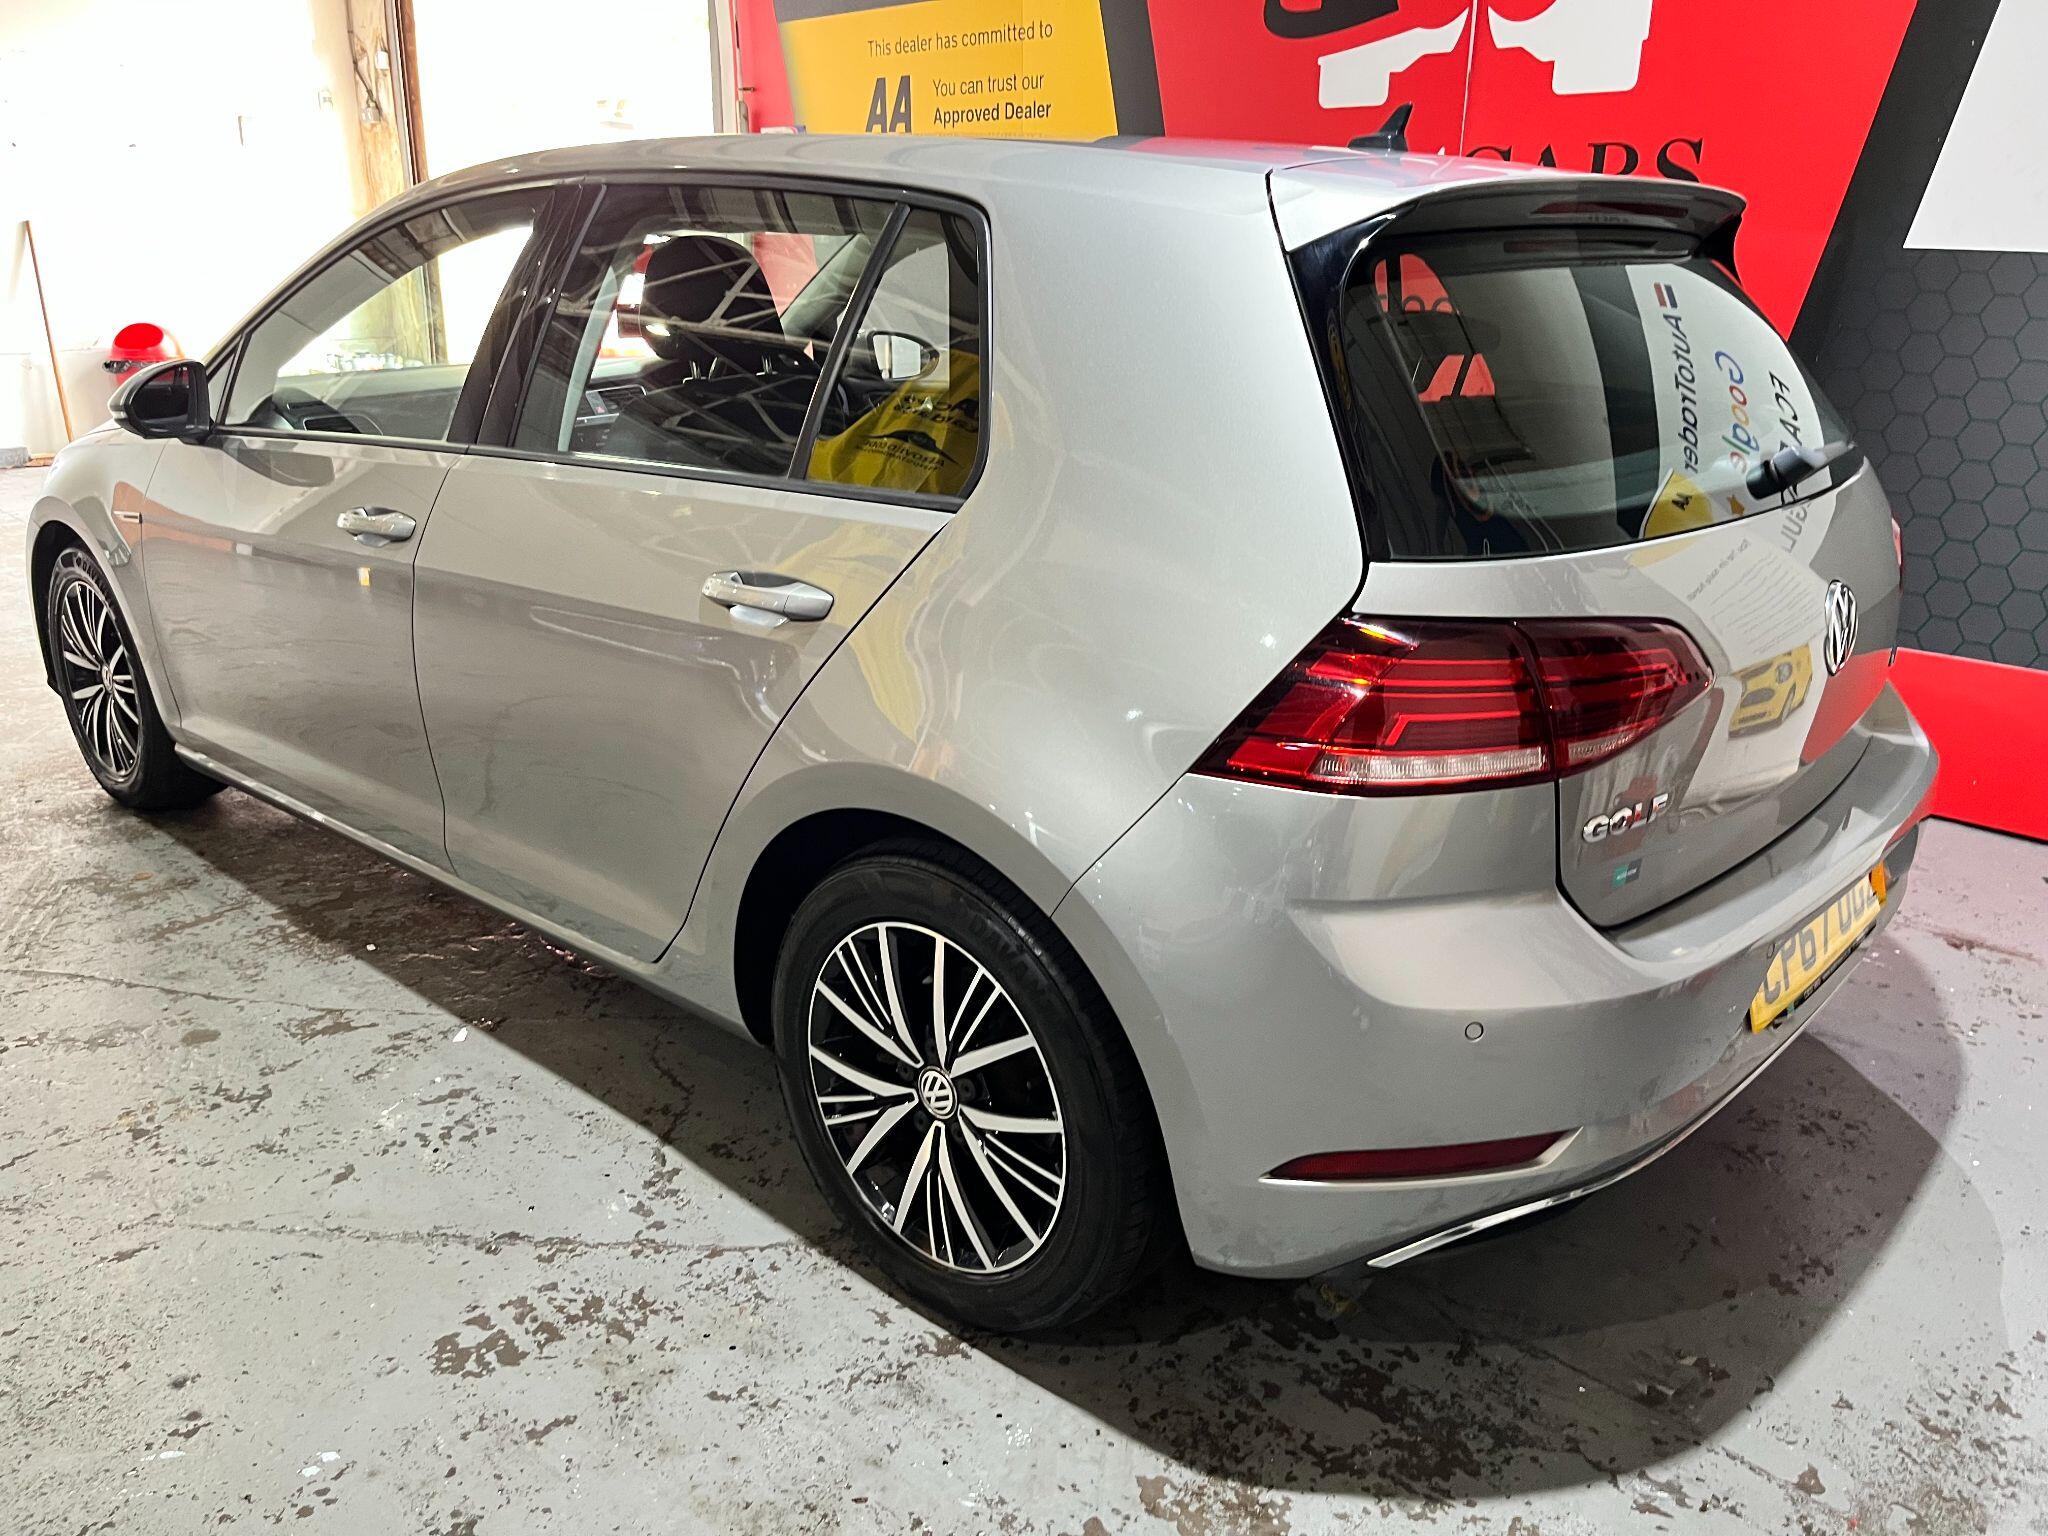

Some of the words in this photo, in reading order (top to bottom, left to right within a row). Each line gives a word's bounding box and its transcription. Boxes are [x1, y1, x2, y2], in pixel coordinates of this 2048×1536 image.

[868, 40, 891, 58] This
[895, 36, 932, 54] dealer
[936, 33, 957, 50] has
[962, 21, 1035, 46] committed
[1039, 20, 1053, 38] to
[865, 75, 912, 133] AA
[932, 79, 955, 96] You
[960, 79, 983, 95] can
[988, 74, 1017, 92] trust
[1022, 74, 1044, 90] our
[934, 103, 999, 129] Approved
[1005, 101, 1051, 120] Dealer
[1466, 138, 1703, 183] RS
[1582, 793, 1669, 843] GOLF
